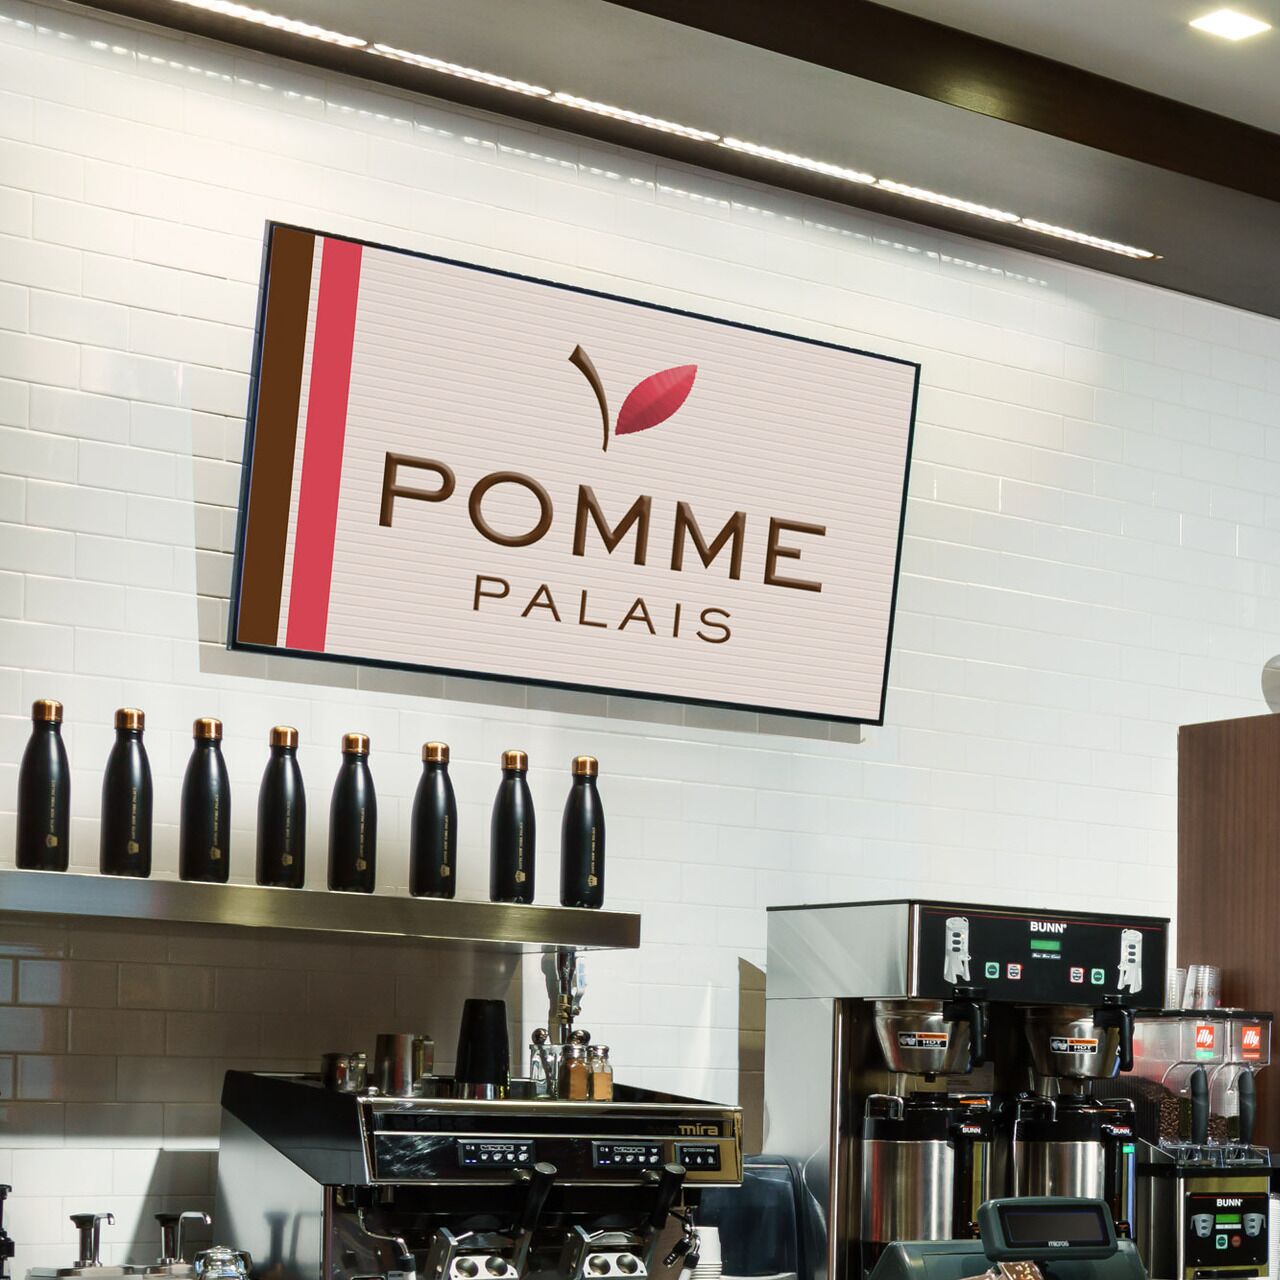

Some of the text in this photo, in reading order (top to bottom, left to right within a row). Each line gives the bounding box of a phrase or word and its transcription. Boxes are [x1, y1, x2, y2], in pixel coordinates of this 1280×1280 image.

[378, 451, 827, 593] POMME
[472, 574, 733, 645] PALAIS
[1030, 921, 1065, 934] BUNN
[1197, 1029, 1213, 1046] illy
[1243, 1030, 1260, 1047] illy
[677, 1123, 719, 1136] mira
[1216, 1198, 1241, 1207] BUNN
